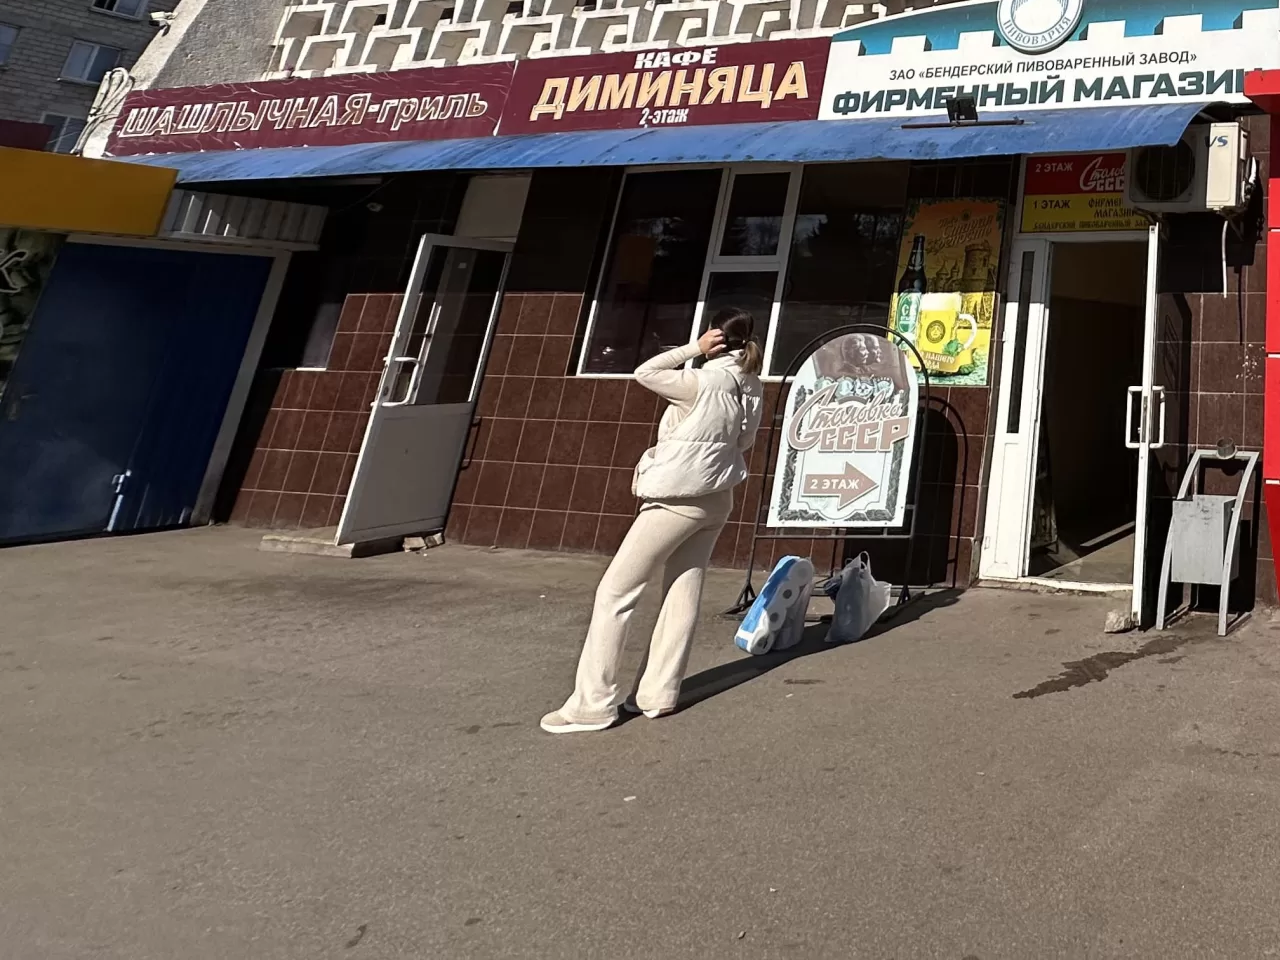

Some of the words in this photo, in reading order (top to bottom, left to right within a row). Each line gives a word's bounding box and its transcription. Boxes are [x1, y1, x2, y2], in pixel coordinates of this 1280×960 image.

[1003, 16, 1071, 45] ПИВОВАРНЯ
[634, 47, 718, 69] КАФЕ
[889, 69, 915, 81] ЗАО
[918, 59, 1013, 80] «БЕНДЕРСКИЙ
[1016, 52, 1135, 74] ПИВОВАРЕННЫЙ
[1139, 51, 1197, 66] ЗАВОД»
[529, 60, 809, 122] ДИМИНЯЦА
[1035, 164, 1041, 173] 2
[1044, 162, 1074, 173] ЭТАЖ
[1034, 202, 1038, 210] 1
[1041, 200, 1071, 210] ЭТАЖ
[818, 416, 910, 453] СССР
[810, 479, 818, 489] 2
[821, 478, 860, 490] ЭТАЖ
